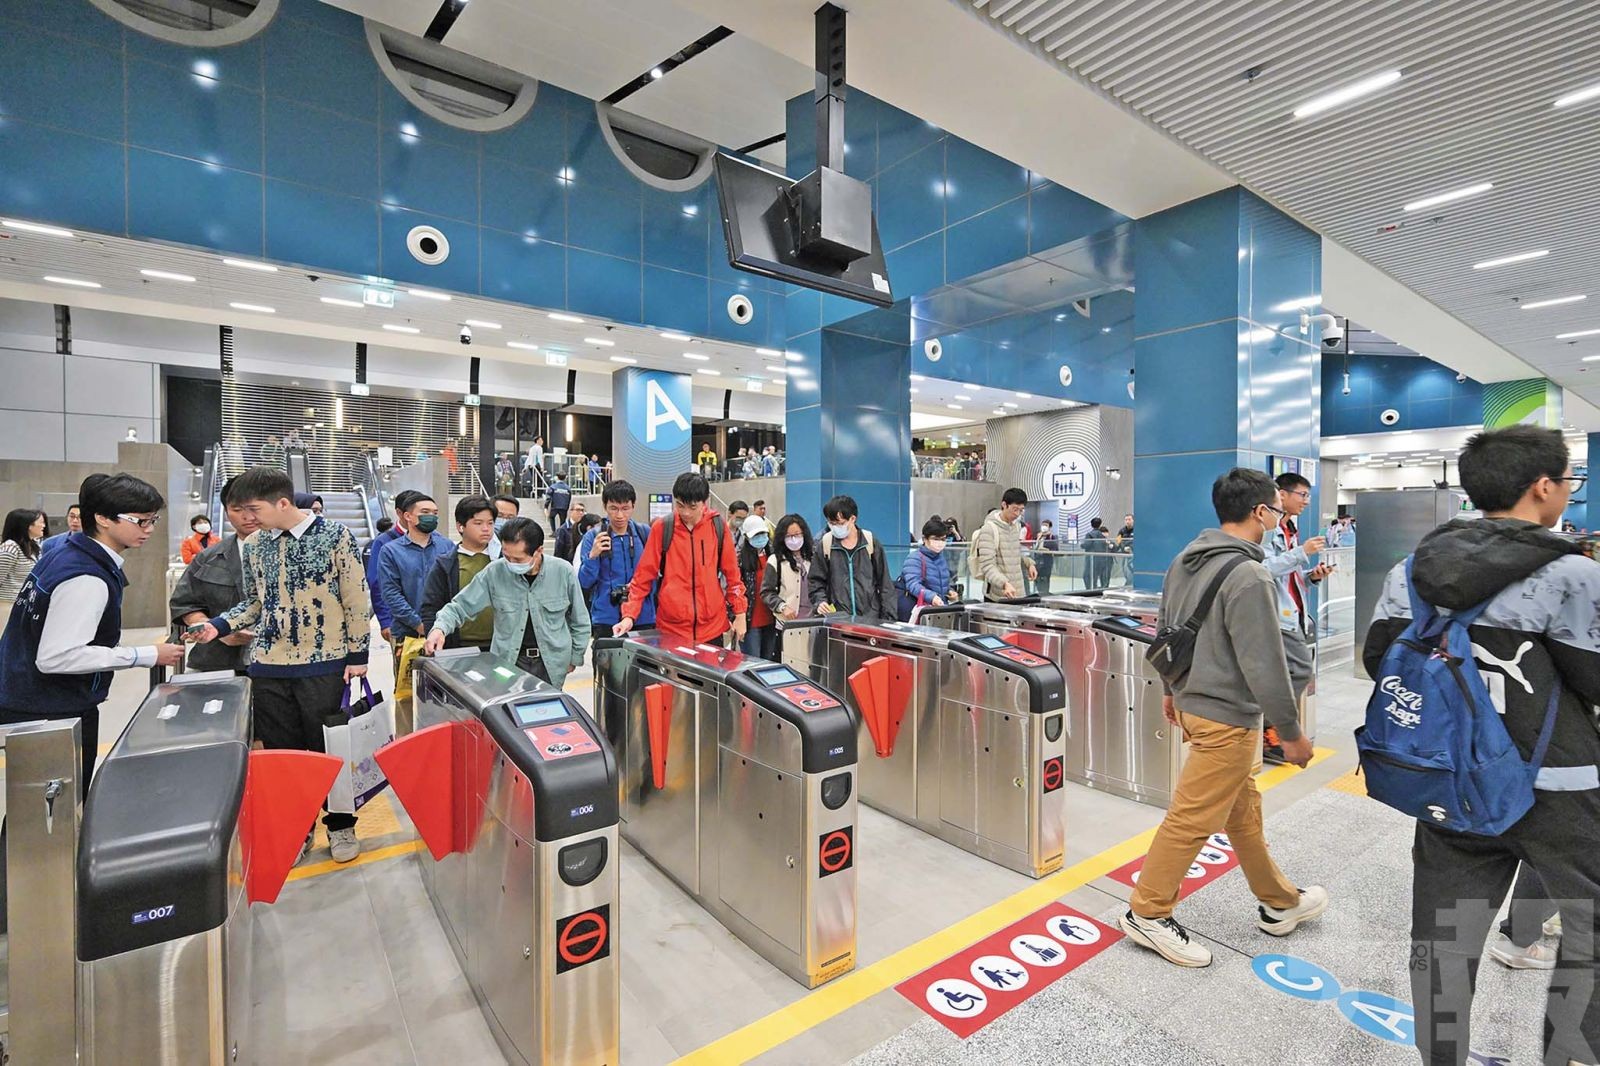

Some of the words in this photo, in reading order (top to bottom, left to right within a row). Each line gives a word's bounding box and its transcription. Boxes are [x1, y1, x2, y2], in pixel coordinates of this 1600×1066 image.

[647, 379, 691, 443] A
[579, 804, 594, 815] 006
[148, 904, 174, 920] 007
[1265, 960, 1323, 992] C
[1351, 1000, 1414, 1039] A
